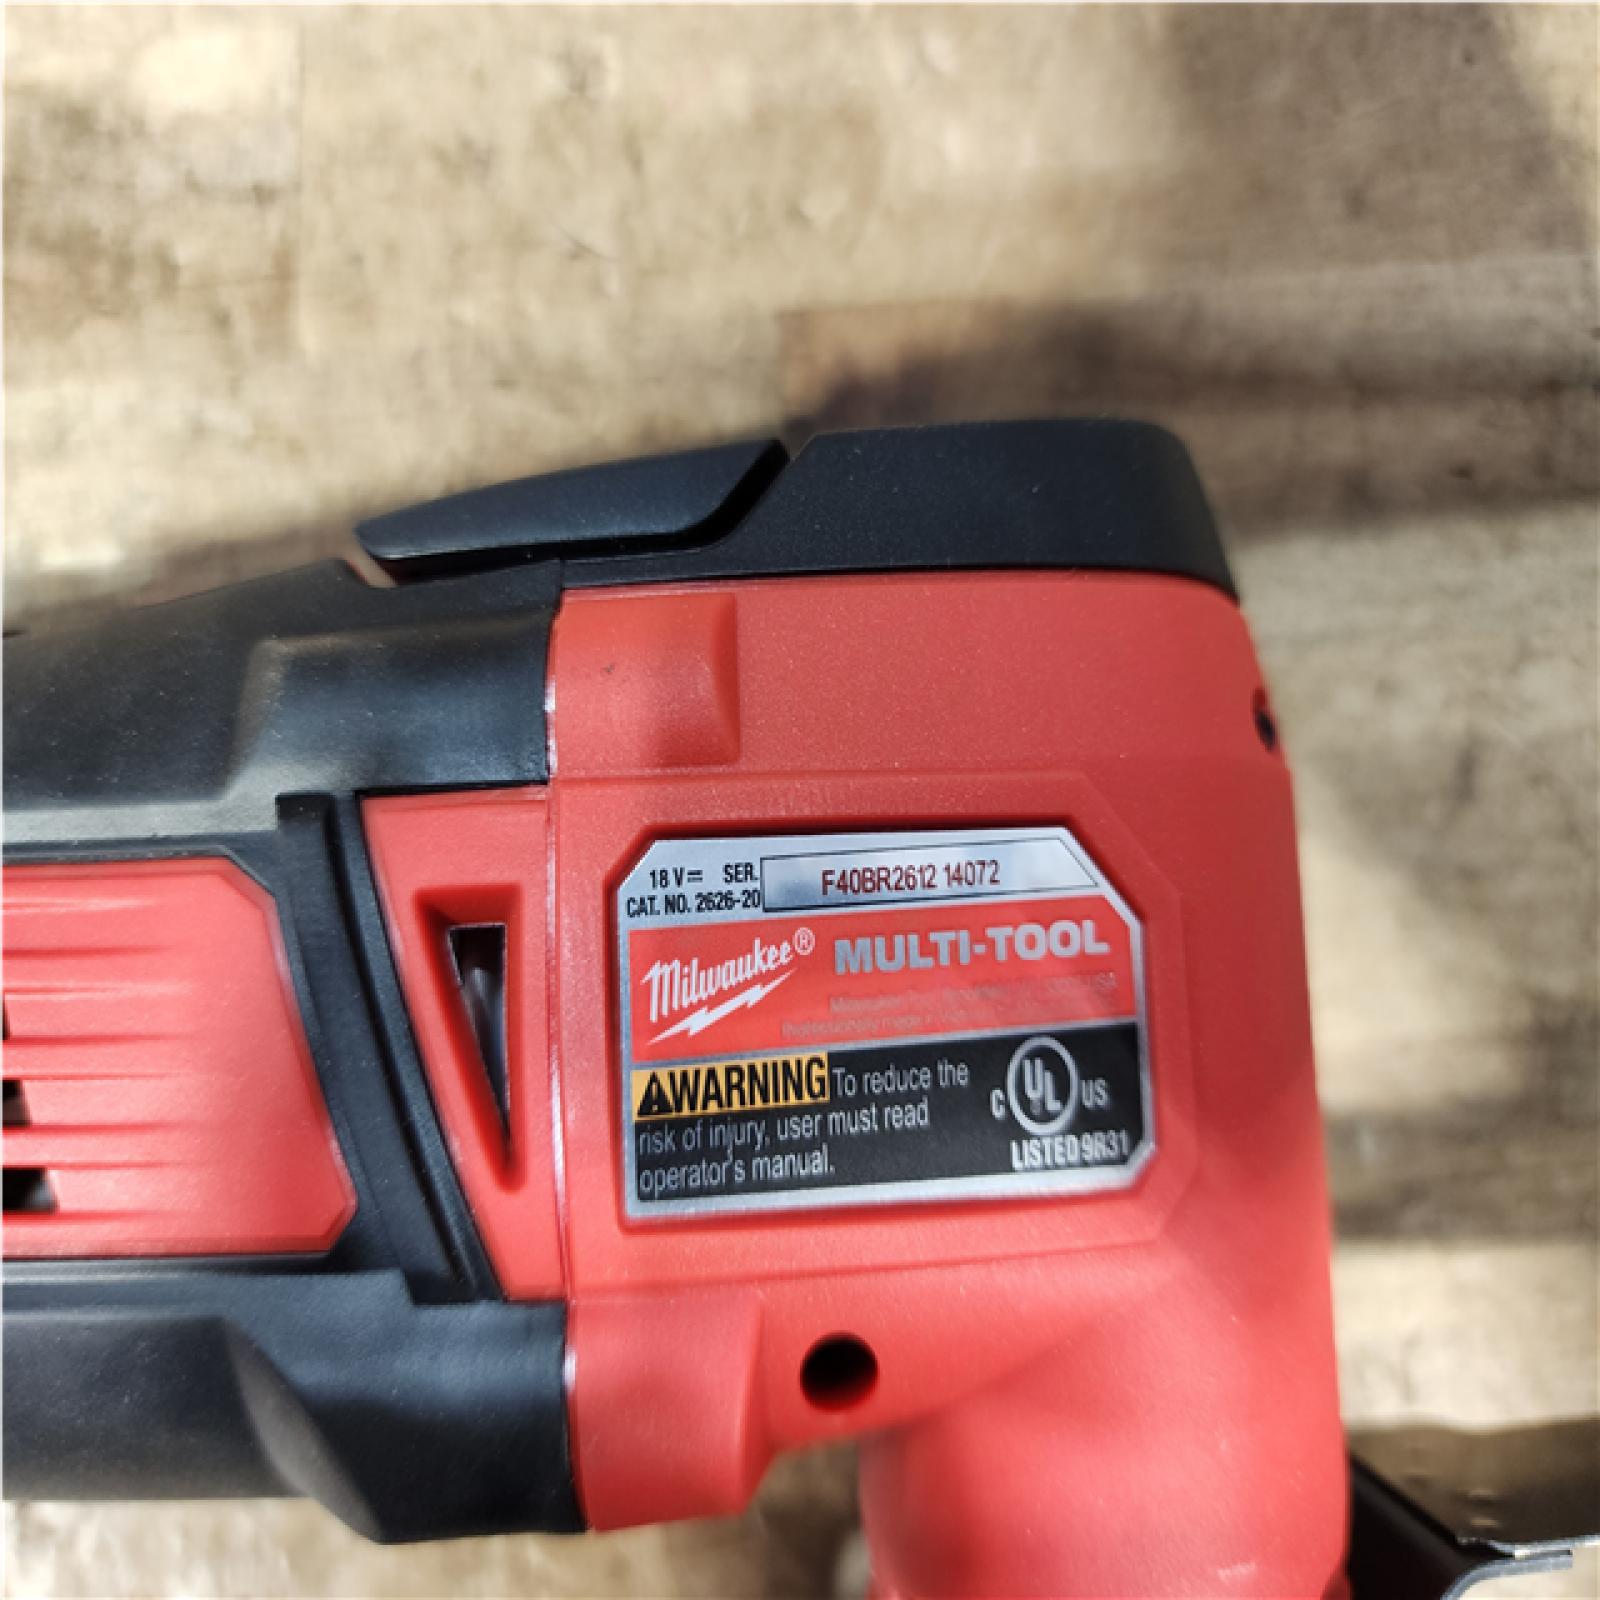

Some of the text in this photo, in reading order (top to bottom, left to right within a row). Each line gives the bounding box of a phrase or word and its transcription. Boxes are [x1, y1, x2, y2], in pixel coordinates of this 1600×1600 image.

[722, 861, 759, 884] SER.
[821, 859, 1001, 896] F40BR2612 14072
[627, 888, 762, 918] CAT. NO. 2626-20
[834, 919, 1110, 975] MULTI-TOOL
[668, 1056, 969, 1114] WARNING To reduce the
[639, 1120, 676, 1156] risk
[682, 1118, 703, 1150] of
[776, 1112, 823, 1142] user
[828, 1102, 878, 1136] must
[884, 1097, 930, 1129] read
[639, 1142, 836, 1200] operator's manual.
[1010, 1134, 1079, 1171] LISTED
